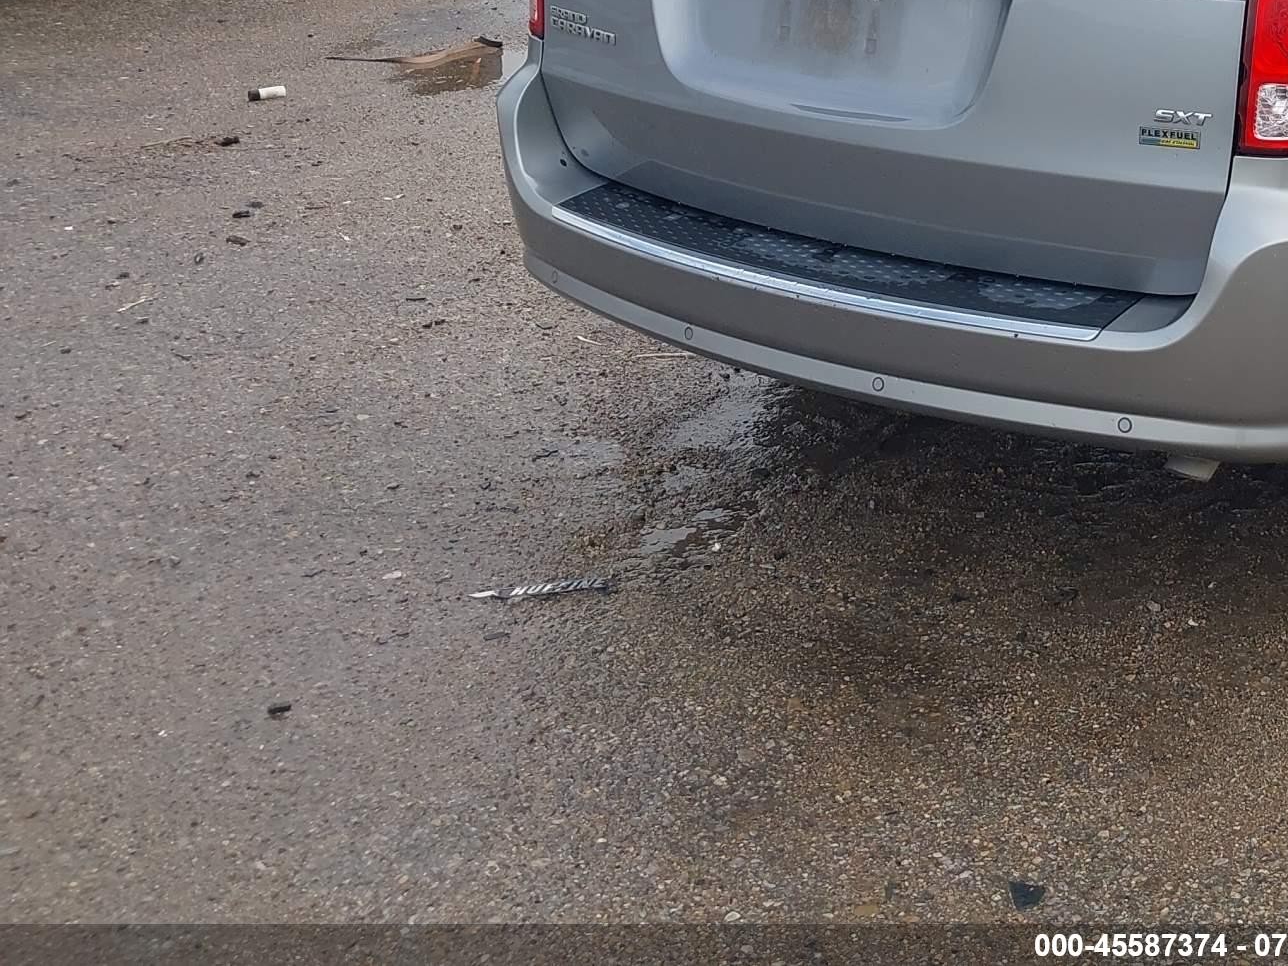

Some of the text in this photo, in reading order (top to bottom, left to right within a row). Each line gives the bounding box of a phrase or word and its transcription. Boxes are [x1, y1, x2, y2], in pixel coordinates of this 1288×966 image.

[550, 5, 588, 24] GRAND
[551, 16, 617, 45] CARAVAN
[1153, 107, 1213, 126] SXT
[1141, 127, 1197, 141] FLEXFUEL
